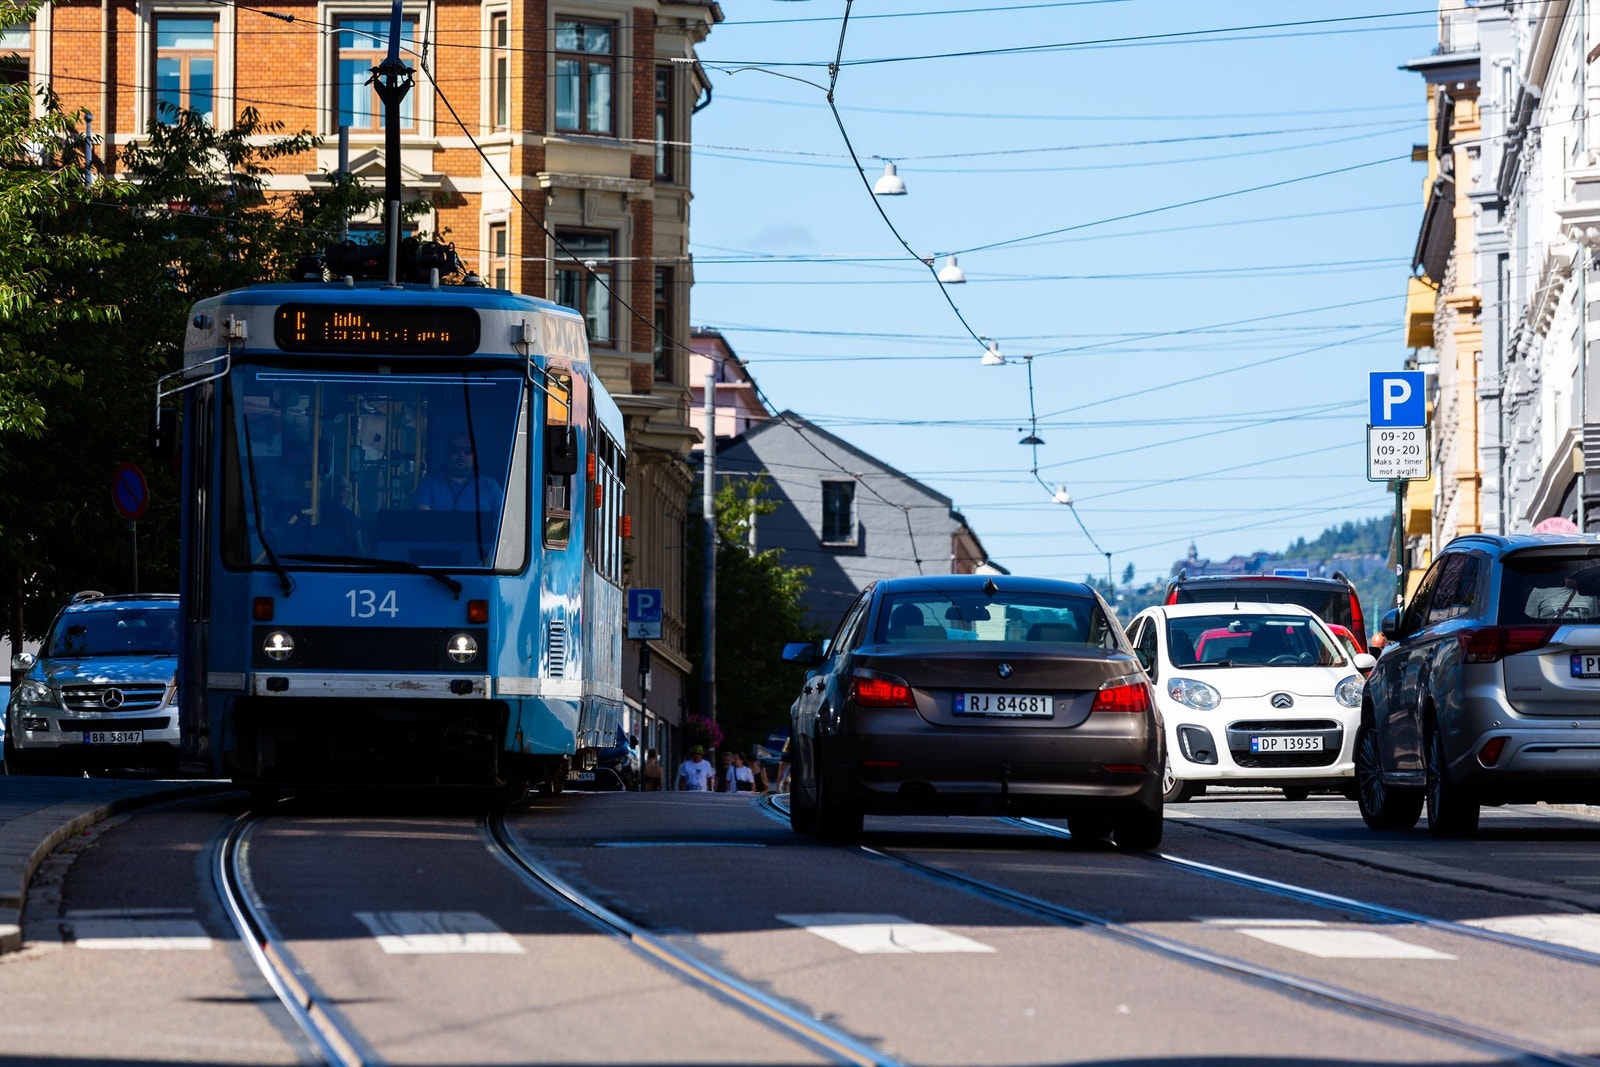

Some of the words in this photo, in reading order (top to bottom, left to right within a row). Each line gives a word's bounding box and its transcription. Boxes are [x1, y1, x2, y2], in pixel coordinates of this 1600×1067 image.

[1383, 379, 1412, 420] P
[1381, 431, 1415, 441] 09-20
[1377, 445, 1420, 456] (09-20)
[1396, 468, 1418, 476] avgift
[345, 589, 399, 618] 134
[637, 594, 654, 617] P
[1586, 658, 1600, 672] P
[970, 696, 989, 711] RJ
[997, 696, 1047, 712] 84681
[92, 733, 105, 742] BR
[111, 732, 140, 742] 58147
[1262, 739, 1278, 750] DP
[1283, 738, 1319, 750] 13955
